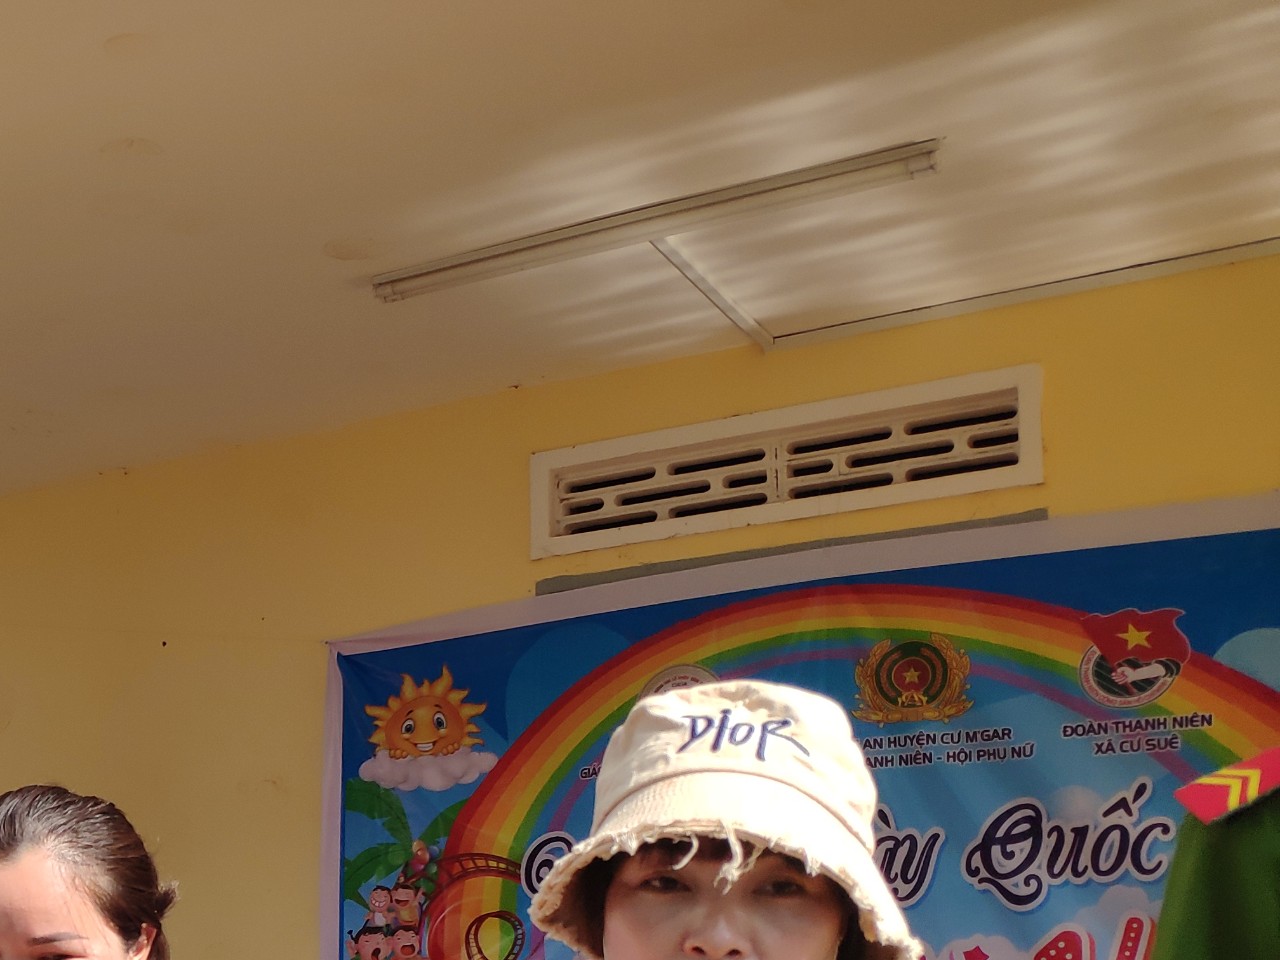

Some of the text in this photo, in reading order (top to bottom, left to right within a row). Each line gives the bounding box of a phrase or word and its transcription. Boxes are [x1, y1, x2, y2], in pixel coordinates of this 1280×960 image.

[1062, 711, 1213, 738] ĐOÀN THANH NIÊN
[863, 727, 1013, 750] AN HUYỆN CƯ M'GAR
[1120, 738, 1141, 753] CƯ
[1146, 733, 1180, 751] SUÊ
[898, 750, 933, 767] NIÊN
[946, 747, 973, 766] HỘI
[976, 747, 1008, 764] PHỤ
[965, 782, 1171, 907] Quốc
